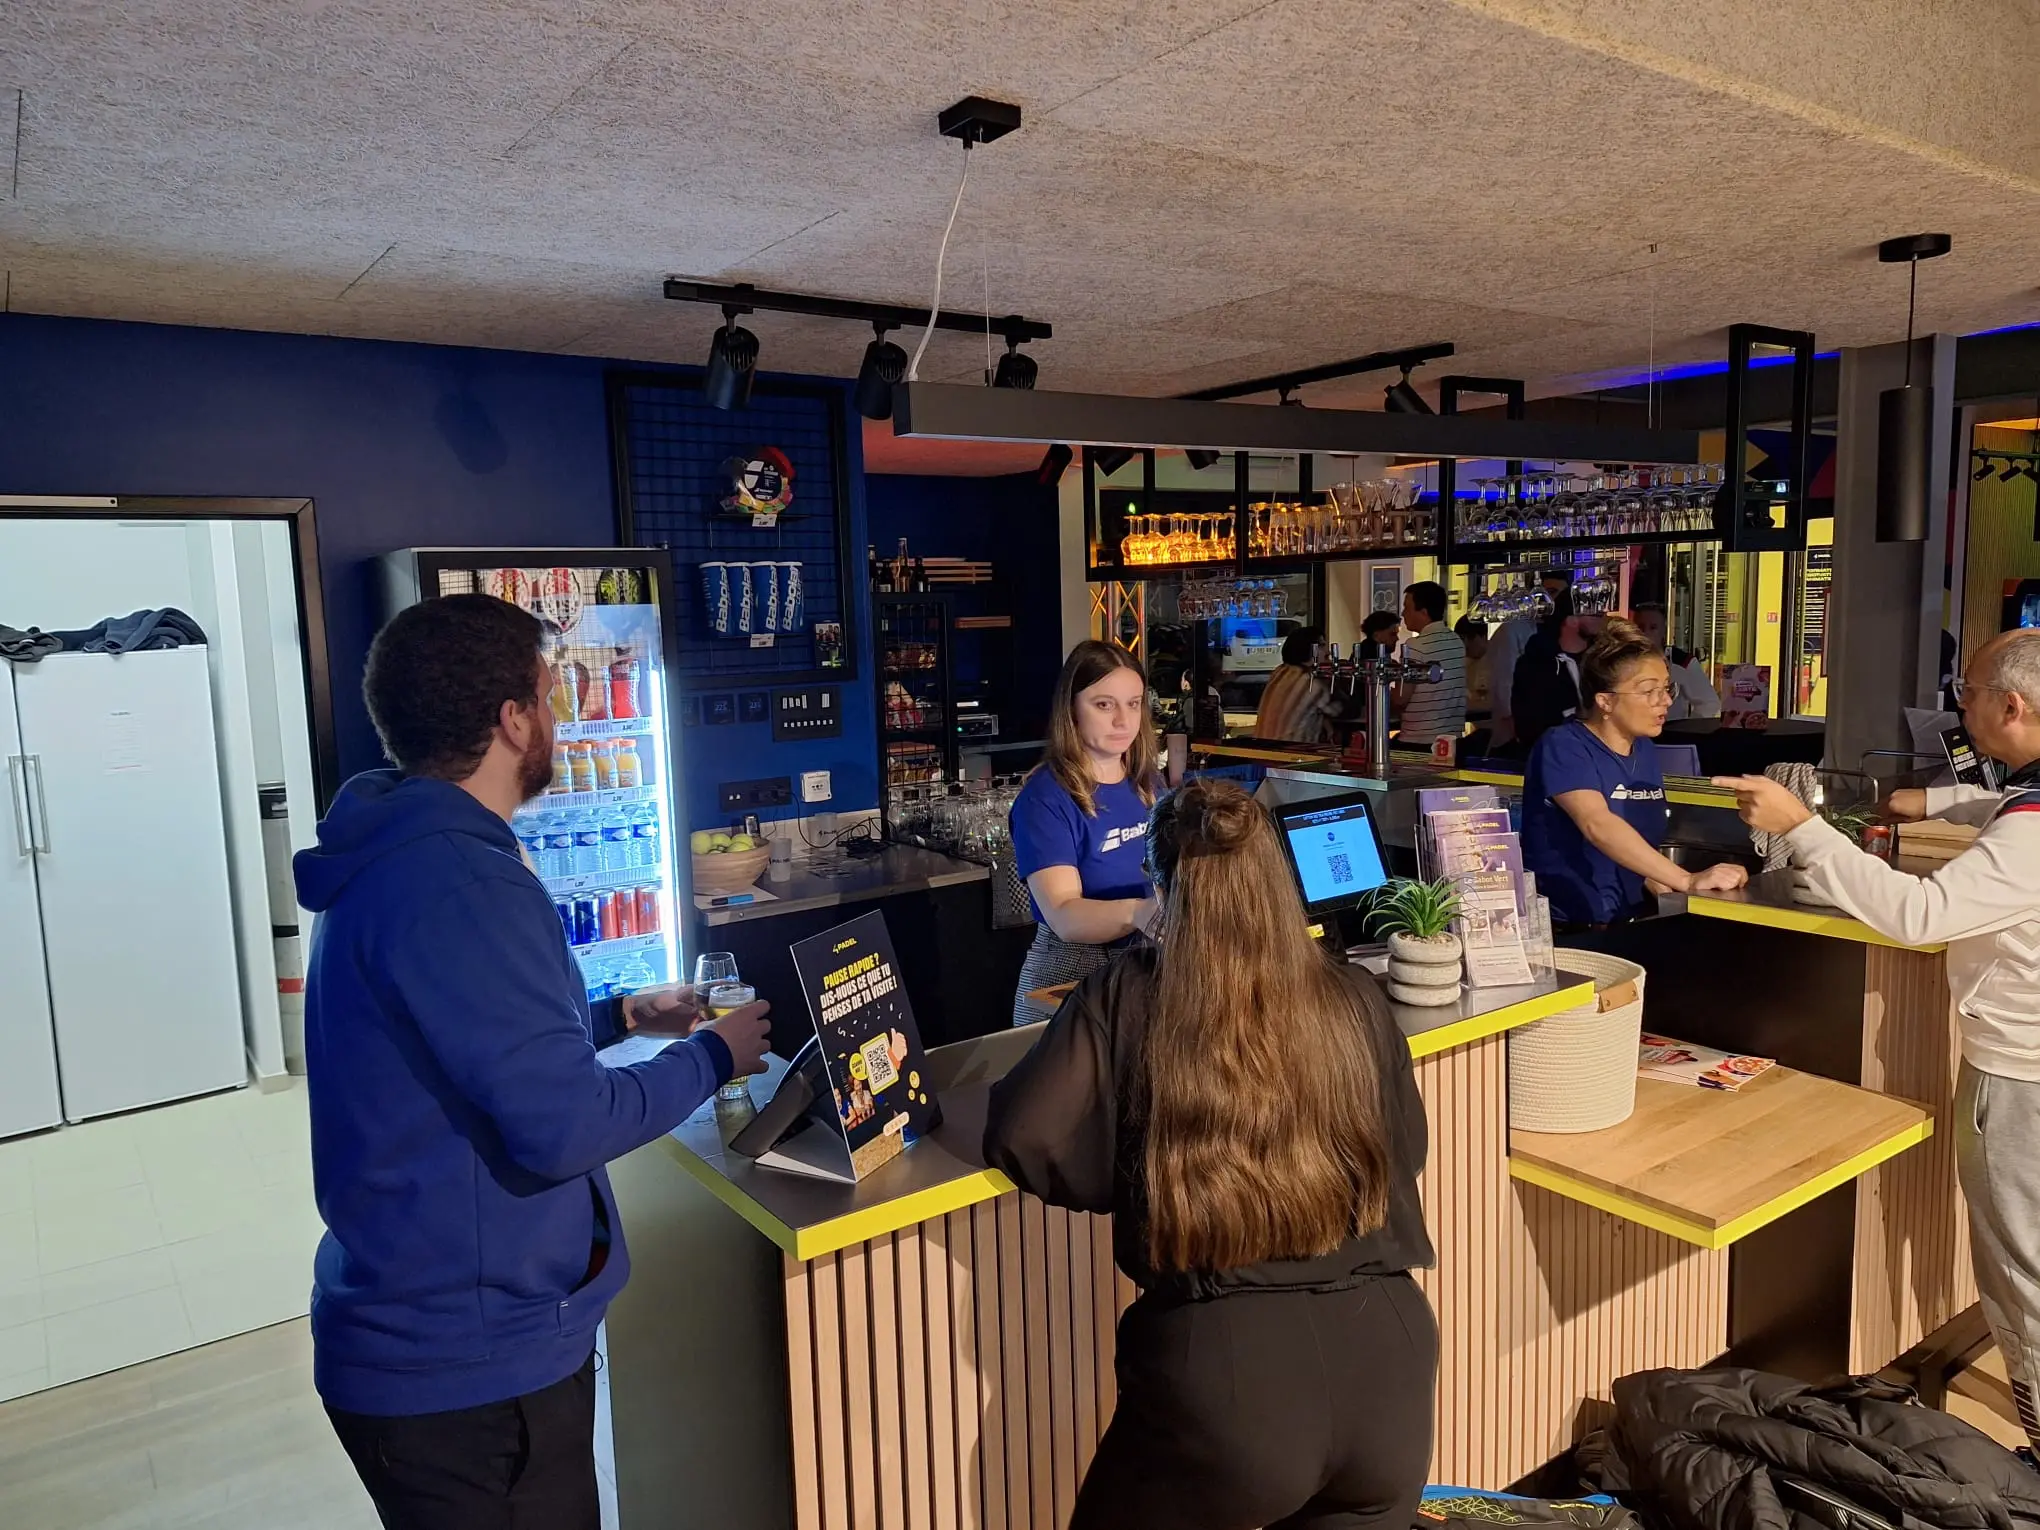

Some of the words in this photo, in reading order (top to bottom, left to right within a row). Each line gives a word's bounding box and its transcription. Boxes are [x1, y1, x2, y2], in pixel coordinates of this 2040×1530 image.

[1121, 821, 1148, 842] Bab
[1493, 874, 1509, 883] Vert
[820, 979, 857, 1009] DIS-NOUS
[857, 974, 868, 990] CE
[866, 967, 882, 987] QUE
[880, 962, 891, 978] TU
[823, 967, 849, 990] PAUSE
[848, 954, 875, 978] RAPIDE
[873, 952, 880, 965] ?
[822, 998, 852, 1025] PENSES
[851, 994, 863, 1010] DE
[861, 989, 873, 1004] TA
[870, 977, 894, 1000] VISITE
[892, 975, 898, 988] !
